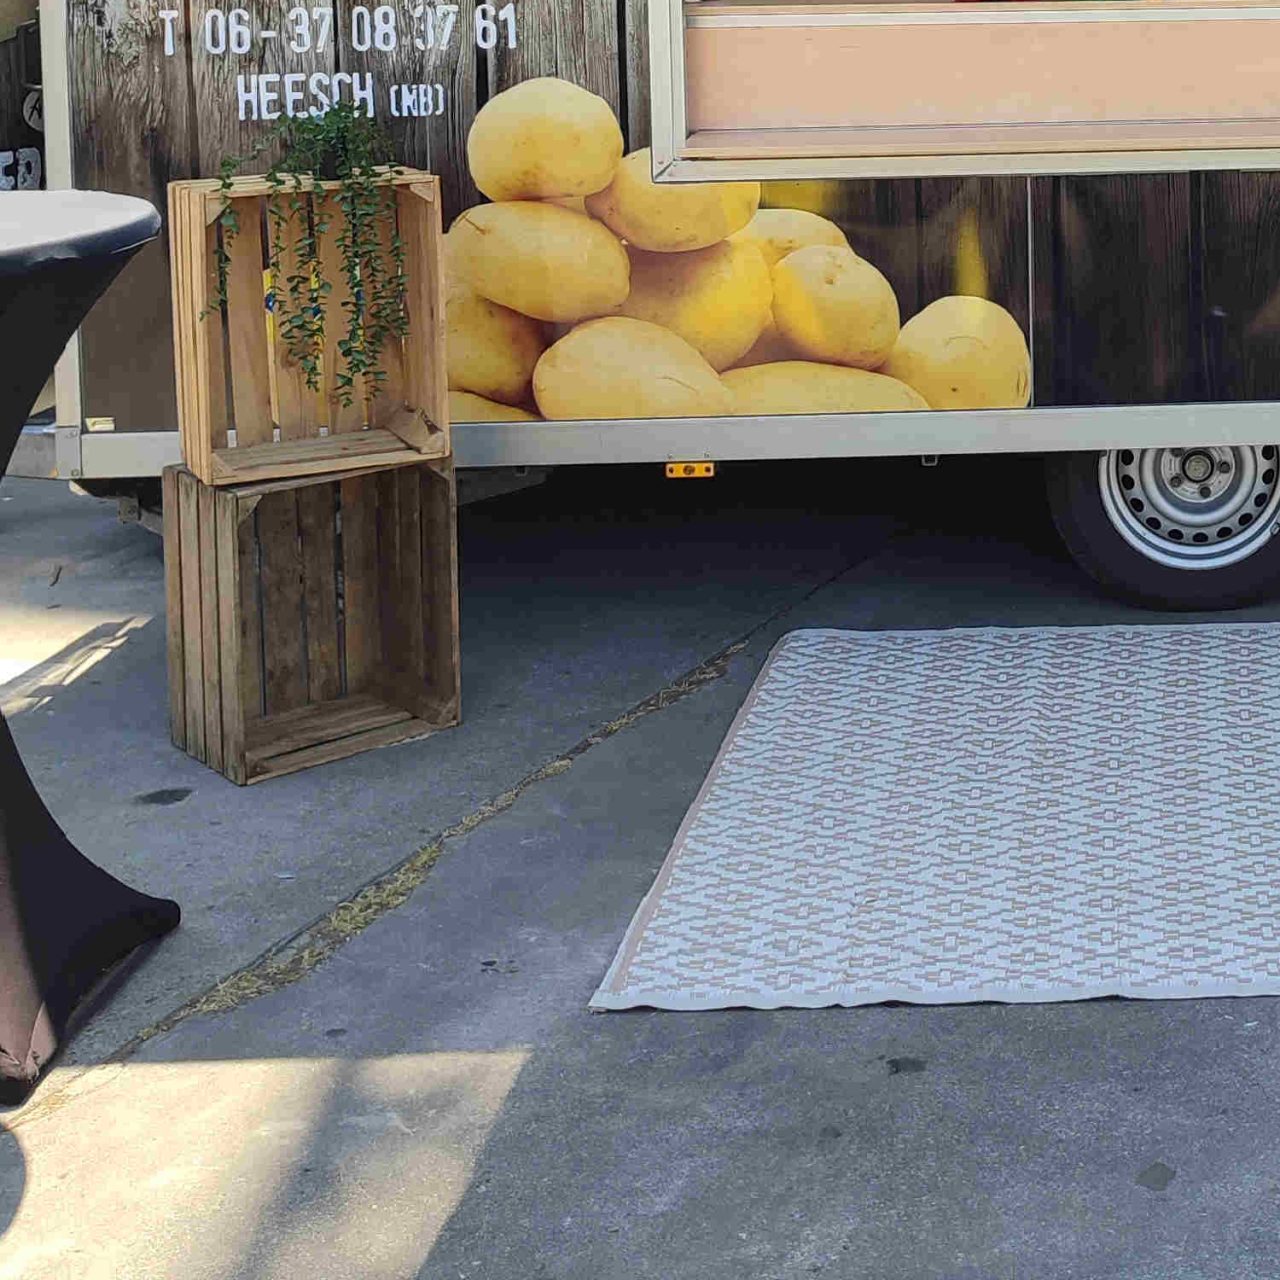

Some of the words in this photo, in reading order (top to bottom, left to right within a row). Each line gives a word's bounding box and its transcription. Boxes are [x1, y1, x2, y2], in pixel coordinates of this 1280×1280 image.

[158, 9, 179, 57] T
[351, 5, 397, 52] 08
[474, 2, 517, 50] 61
